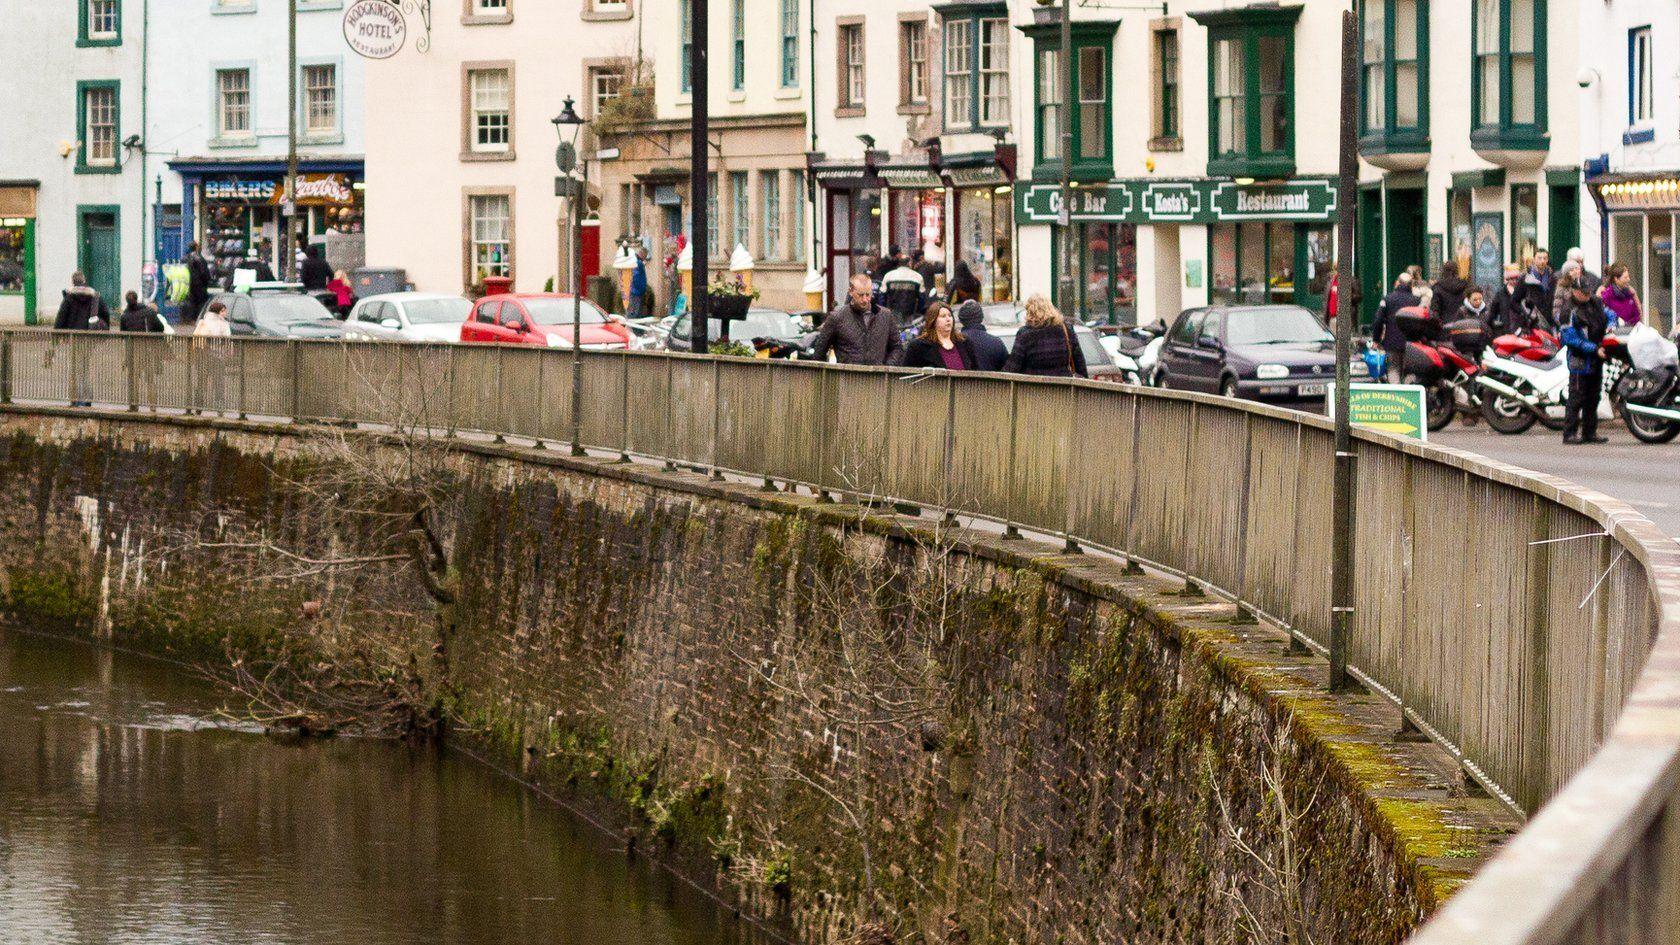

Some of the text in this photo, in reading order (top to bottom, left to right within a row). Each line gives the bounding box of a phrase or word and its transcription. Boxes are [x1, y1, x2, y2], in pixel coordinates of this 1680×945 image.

[347, 3, 403, 34] HODGKINSON'S
[359, 22, 392, 39] HOTEL
[353, 38, 395, 55] RESTAURANT
[205, 180, 275, 198] BIKERS
[1050, 191, 1107, 212] Cae Bar
[1155, 192, 1188, 213] Kosta's
[1237, 190, 1310, 211] Restaurant
[1350, 404, 1406, 413] TRADITIONAL
[1372, 392, 1417, 411] DERBYSHIRE
[1379, 413, 1401, 421] CHIPS
